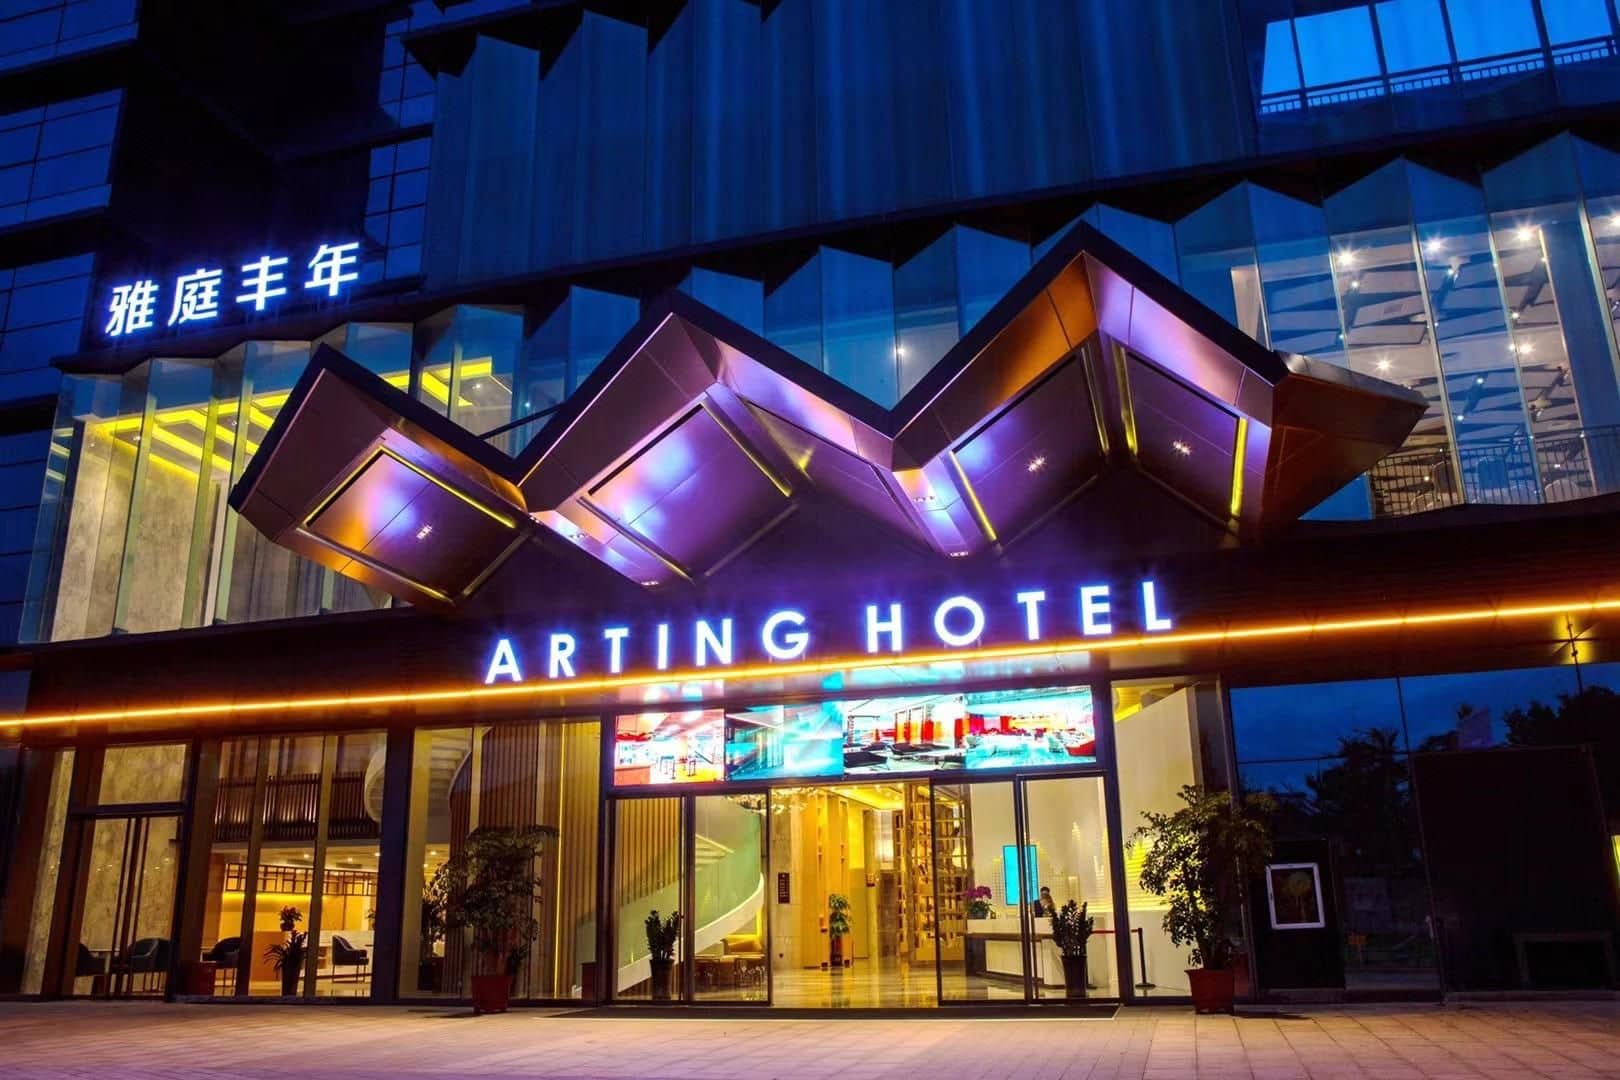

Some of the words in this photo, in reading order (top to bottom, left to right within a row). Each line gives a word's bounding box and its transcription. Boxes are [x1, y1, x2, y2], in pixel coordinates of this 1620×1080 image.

[105, 242, 359, 336] 雅庭丰年
[485, 610, 809, 685] ARTING
[866, 581, 1172, 653] HOTEL
